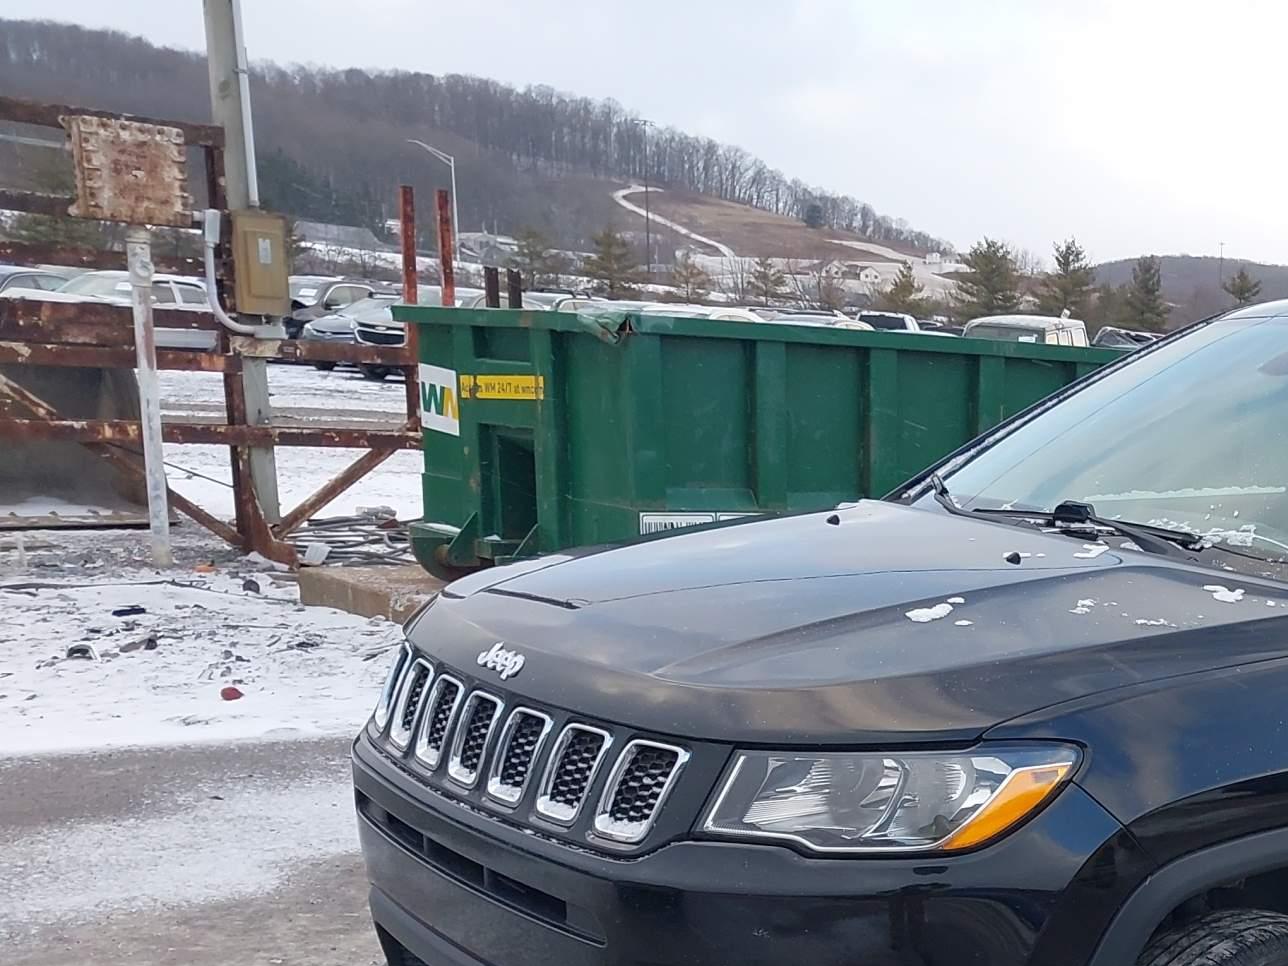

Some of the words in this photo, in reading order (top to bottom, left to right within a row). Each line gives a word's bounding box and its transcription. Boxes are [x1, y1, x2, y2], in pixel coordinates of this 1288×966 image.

[421, 381, 459, 420] WM
[484, 382, 496, 393] WM
[497, 382, 512, 394] 24/7
[477, 641, 525, 680] Jeep
